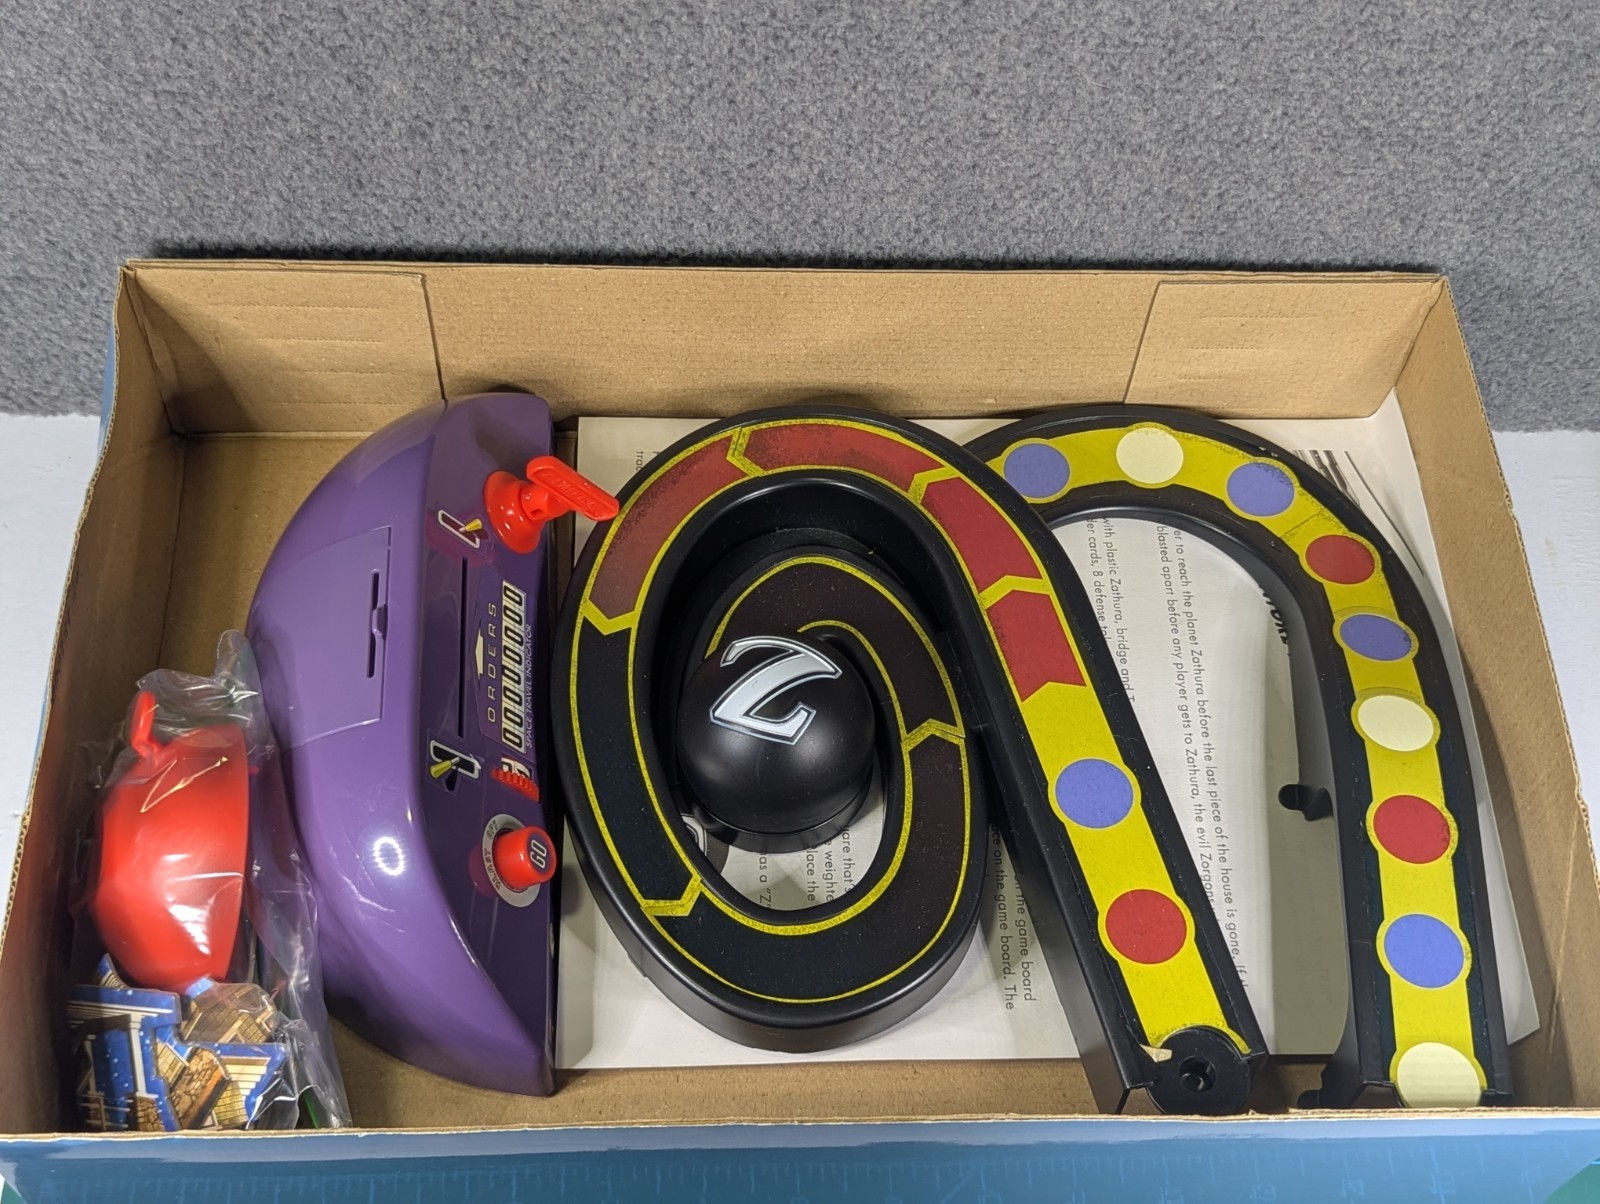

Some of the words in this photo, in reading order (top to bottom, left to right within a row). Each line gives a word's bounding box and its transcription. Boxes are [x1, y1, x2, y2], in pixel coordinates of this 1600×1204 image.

[1088, 537, 1102, 566] cards,
[1103, 542, 1118, 575] plastic
[1157, 525, 1172, 562] blasted
[1176, 544, 1184, 554] to
[1160, 566, 1174, 595] apart
[1178, 558, 1192, 586] reach
[1094, 580, 1107, 623] defense
[1110, 578, 1124, 624] Zathura,
[1182, 591, 1194, 607] the
[1167, 600, 1181, 634] before
[1182, 611, 1199, 645] planet
[525, 624, 533, 676] INDICATOR
[1116, 628, 1130, 664] bridge
[1172, 638, 1182, 658] any
[488, 603, 497, 723] ORDERS
[1191, 650, 1205, 695] Zathura
[709, 635, 843, 746] Z
[1121, 669, 1135, 690] and
[1173, 663, 1188, 700] player
[525, 682, 533, 711] TRAVEL
[525, 713, 533, 749] SPACE
[1178, 705, 1192, 728] gets
[1197, 700, 1211, 738] before
[1184, 733, 1193, 744] to
[1203, 743, 1215, 761] the
[1186, 749, 1200, 799] Zathura,
[1205, 767, 1217, 786] last
[1193, 804, 1206, 822] the
[1207, 791, 1221, 822] piece
[1197, 827, 1211, 848] evil
[1215, 827, 1228, 839] of
[530, 839, 547, 869] GO
[993, 850, 1002, 866] on
[1217, 844, 1230, 863] the
[759, 874, 768, 883] a
[807, 880, 820, 902] the
[995, 868, 1009, 890] the
[1220, 868, 1232, 904] house
[994, 894, 1009, 931] game
[1226, 909, 1237, 918] is
[1015, 919, 1029, 957] game
[1226, 922, 1240, 959] gone.
[1000, 935, 1016, 981] board.
[1021, 960, 1036, 1001] board
[1004, 985, 1018, 1010] The
